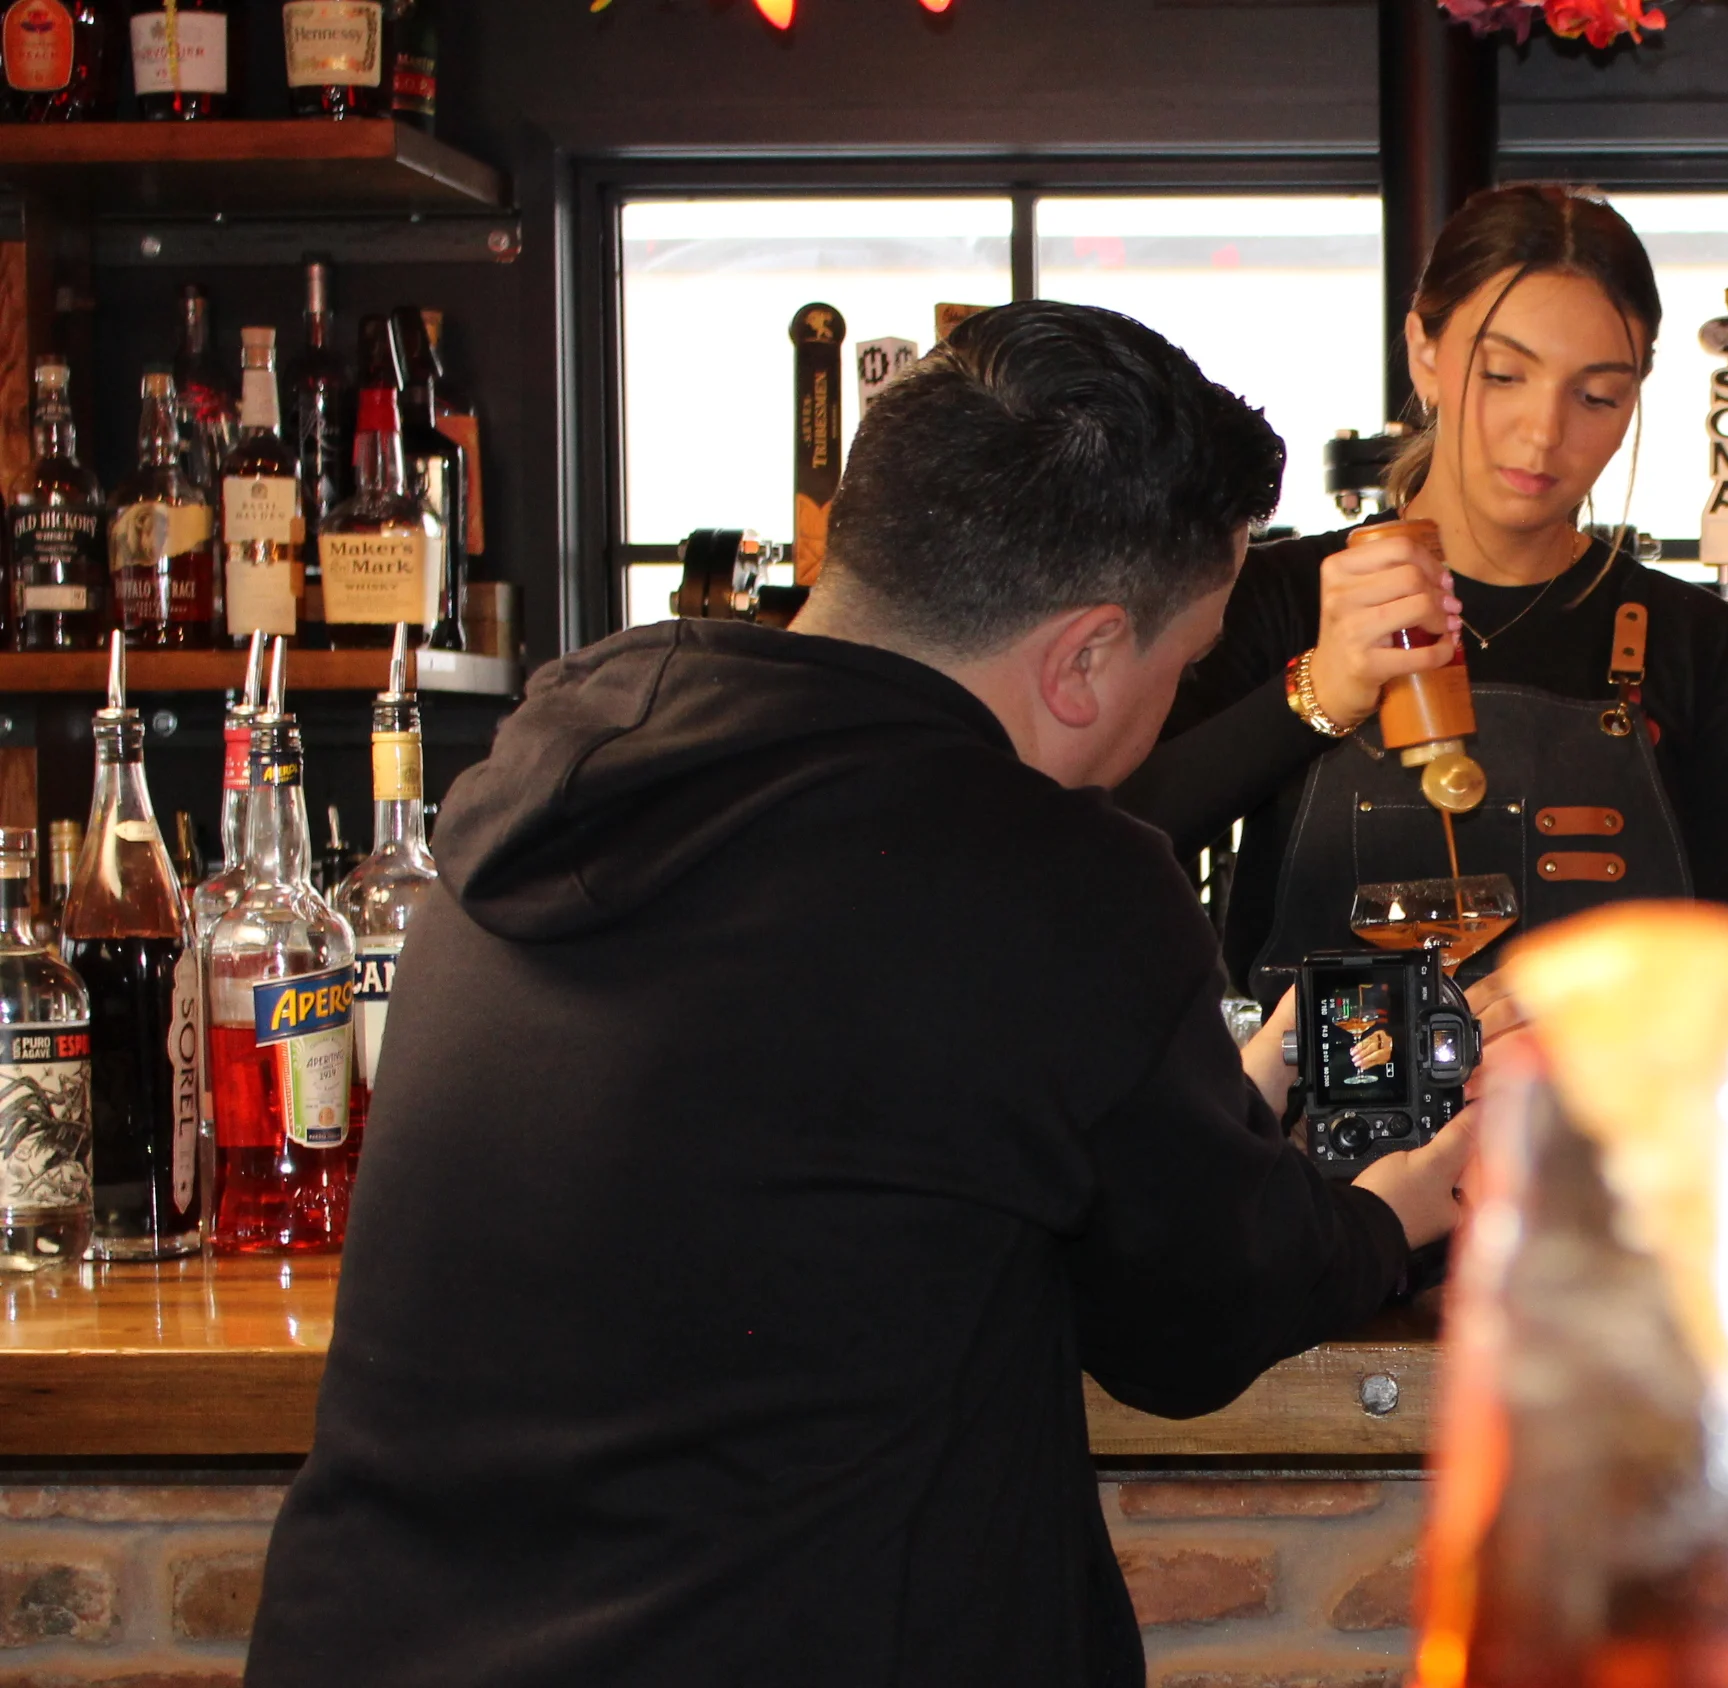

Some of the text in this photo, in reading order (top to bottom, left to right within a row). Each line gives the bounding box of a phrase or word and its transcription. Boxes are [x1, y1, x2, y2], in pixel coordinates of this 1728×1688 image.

[293, 27, 364, 43] Hennessy
[812, 370, 828, 469] TRIBESMEN
[15, 510, 98, 538] OLD HICKORY
[330, 541, 414, 556] Maker's
[352, 559, 413, 574] Mark
[263, 763, 298, 782] AEROL
[22, 1036, 51, 1049] PURO
[22, 1048, 51, 1059] AGAVE
[179, 998, 196, 1136] SOREL
[319, 1068, 337, 1081] 1919
